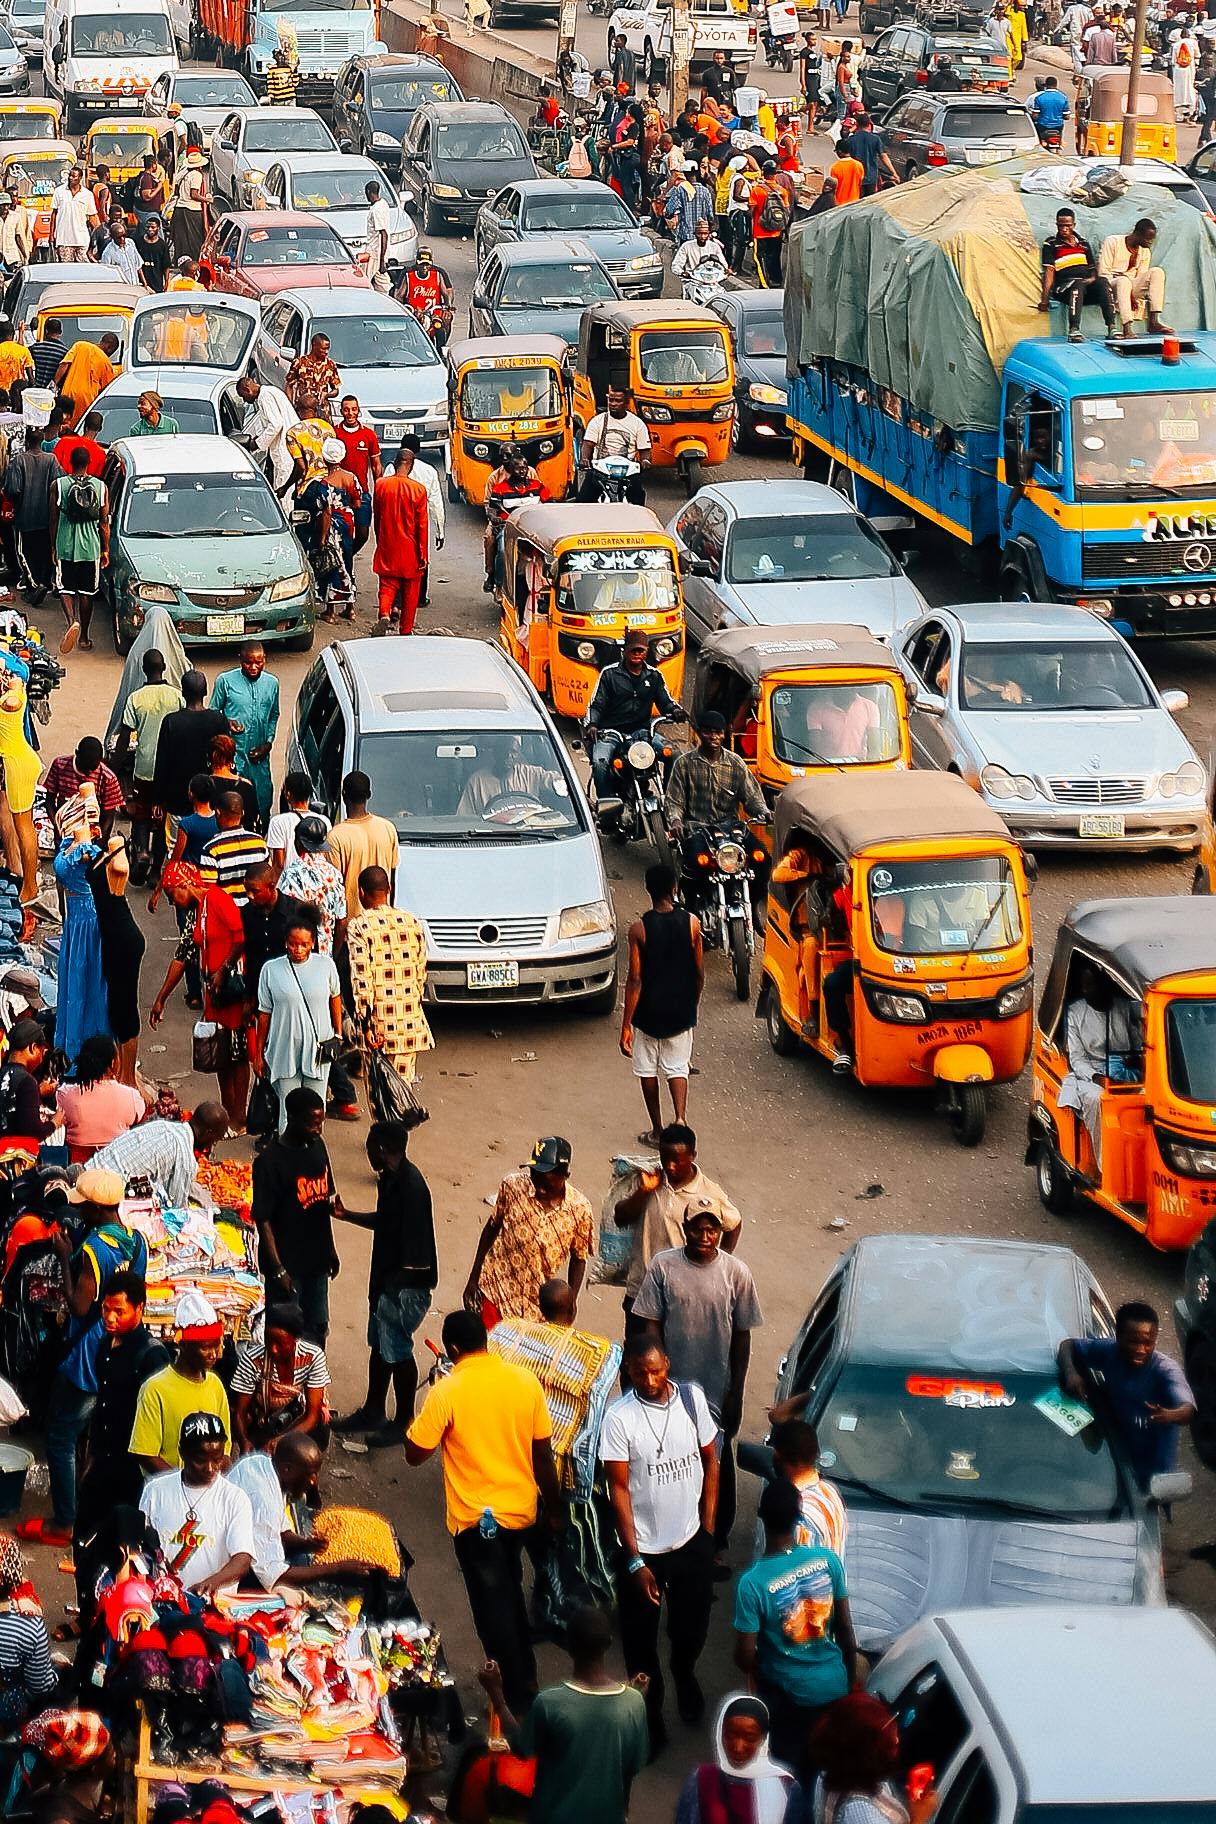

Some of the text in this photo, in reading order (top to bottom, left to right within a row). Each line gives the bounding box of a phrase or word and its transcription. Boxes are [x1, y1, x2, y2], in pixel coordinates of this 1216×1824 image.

[695, 31, 737, 41] OYOTA
[414, 286, 436, 299] Phila
[1046, 1397, 1082, 1428] LAGOS
[658, 1476, 670, 1486] FLY
[769, 1560, 829, 1594] GRAND CANYON
